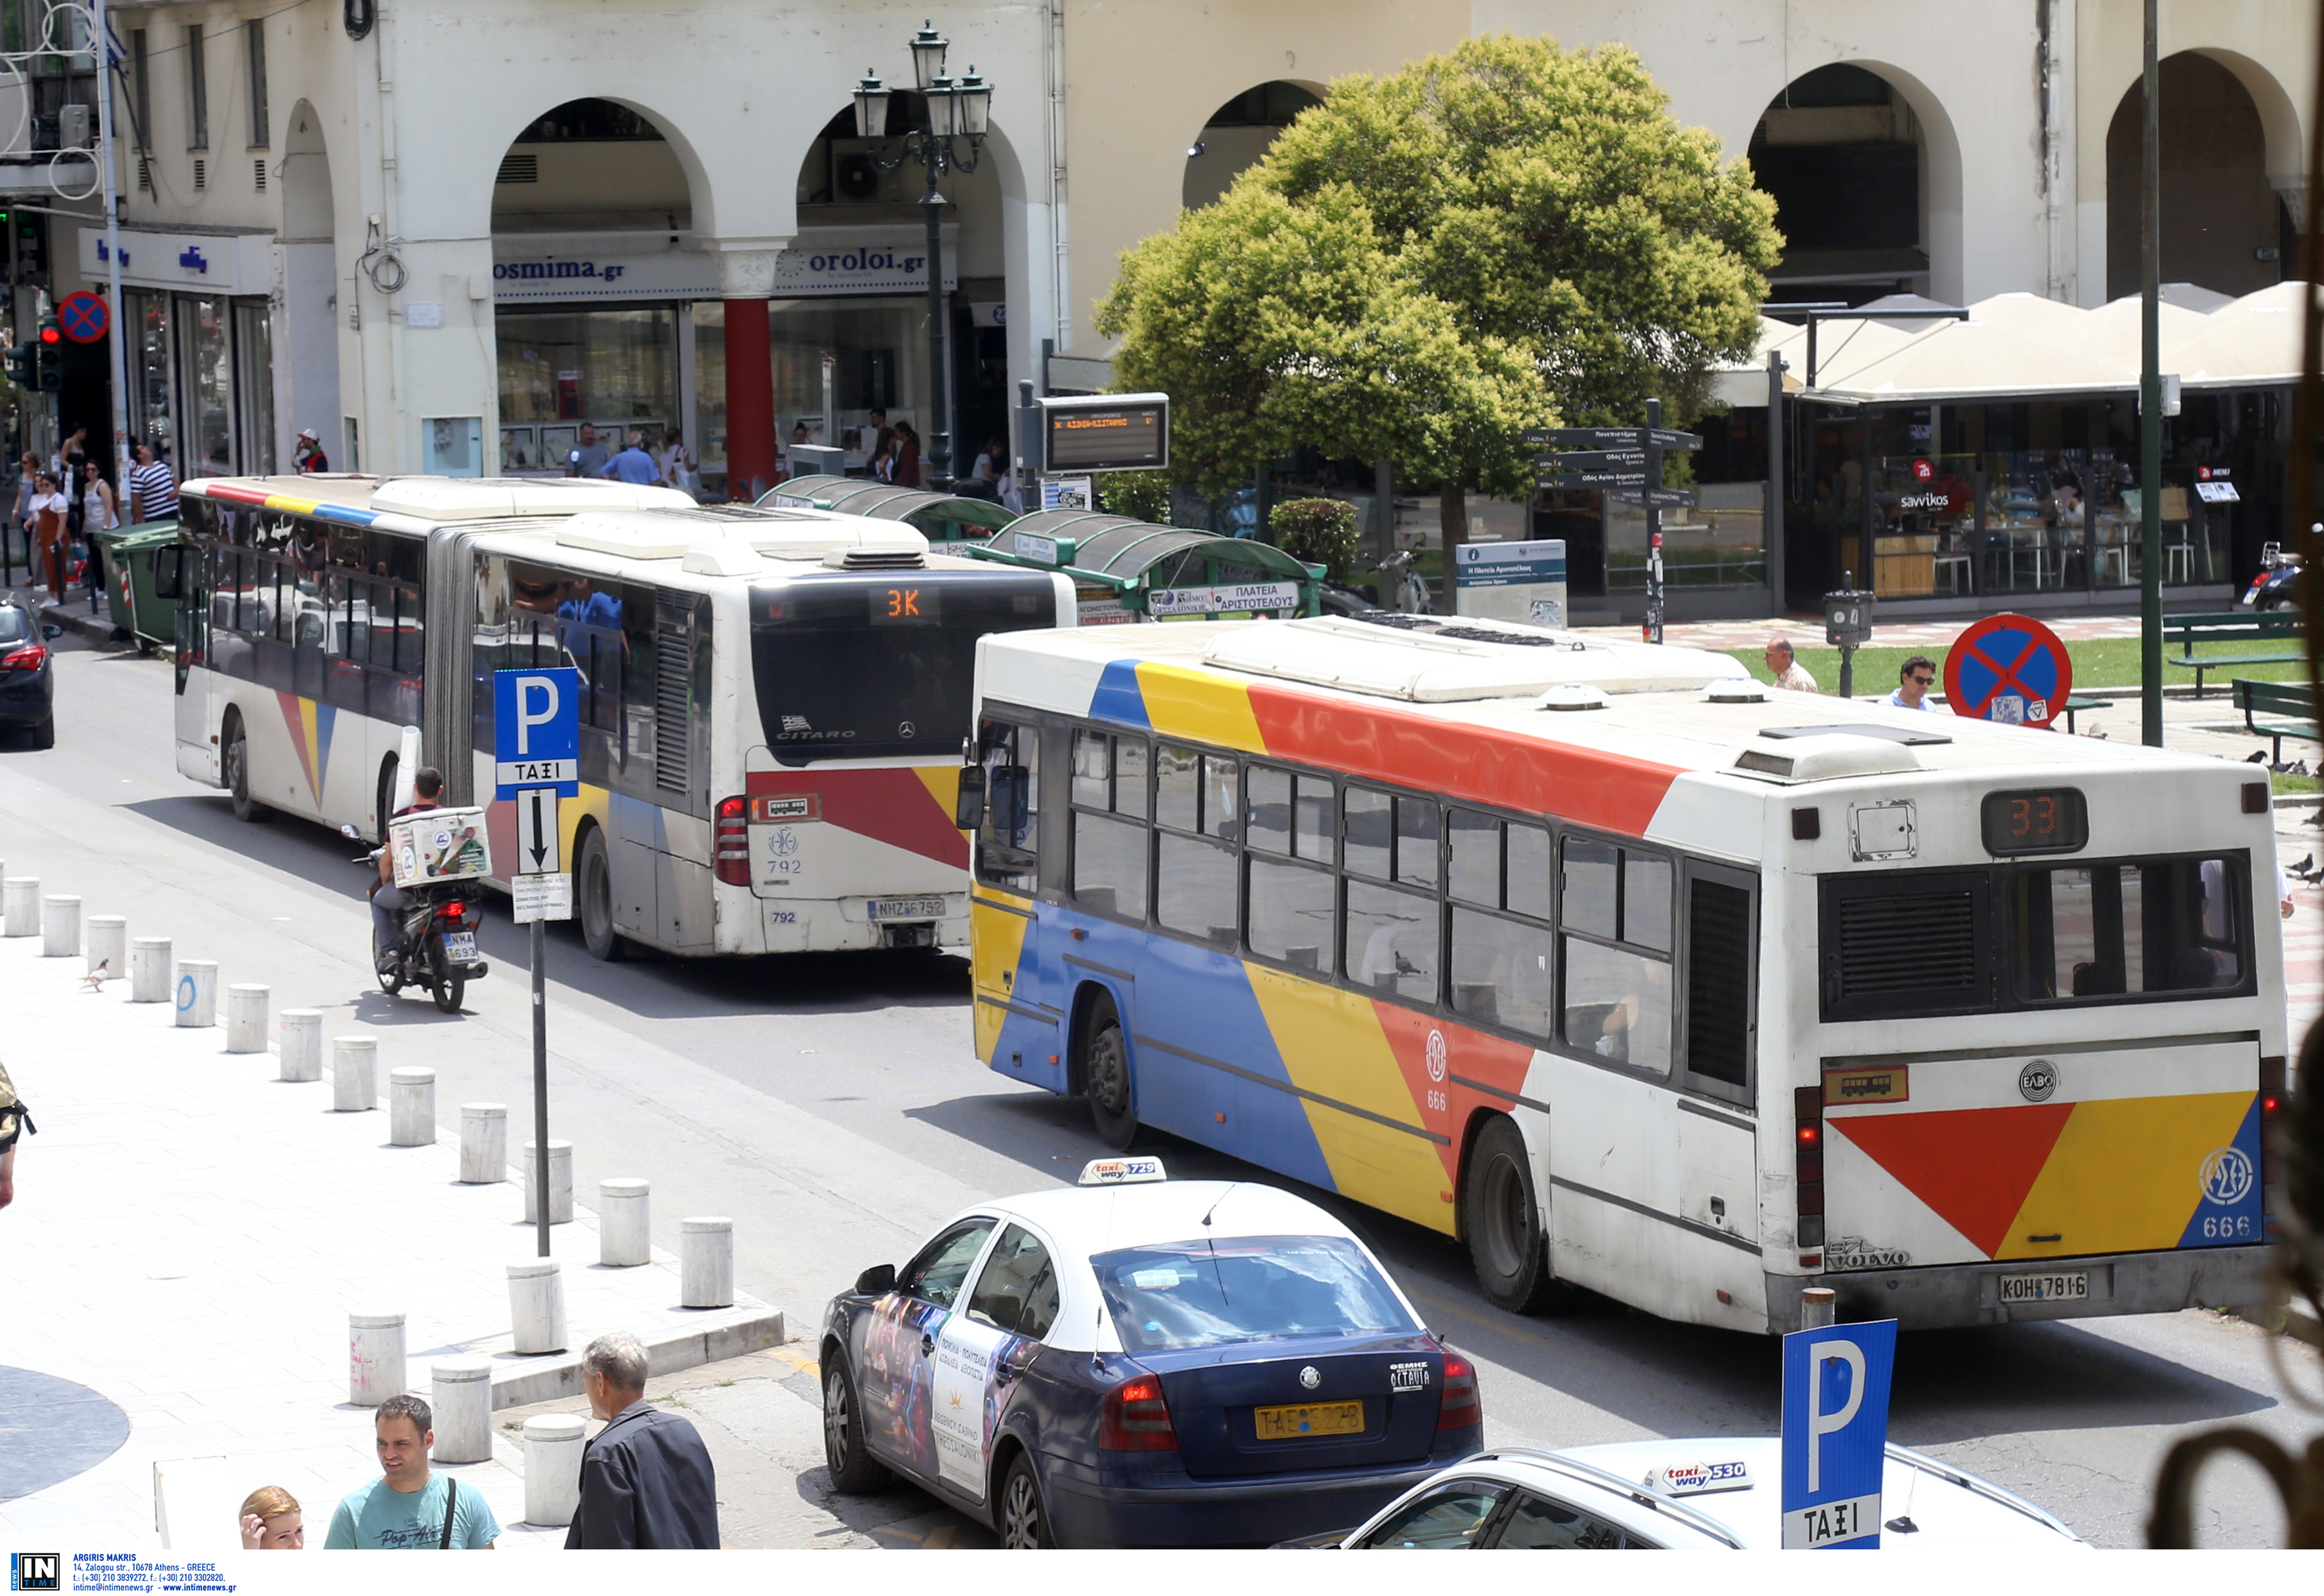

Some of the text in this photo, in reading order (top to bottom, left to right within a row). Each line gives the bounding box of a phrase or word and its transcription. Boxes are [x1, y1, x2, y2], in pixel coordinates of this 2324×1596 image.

[810, 247, 926, 273] oroloi.gr
[2212, 468, 2230, 476] MENU
[1901, 493, 1949, 508] savvikos
[1236, 585, 1278, 597] ΠΛΑΤΕΙΑ
[888, 590, 919, 615] 3K
[1221, 597, 1294, 610] ΑΡΙΣΤΟΤΕΛΟΥΣ
[516, 676, 559, 754] P
[776, 730, 855, 740] CITARO
[2011, 796, 2055, 834] 33
[767, 860, 801, 874] 792
[772, 912, 795, 922] 792
[455, 947, 475, 958] 693
[1428, 1090, 1446, 1112] 666
[1096, 1163, 1119, 1172] taxi
[1131, 1163, 1154, 1174] 729
[2204, 1216, 2250, 1238] 666
[1827, 1250, 1910, 1268] VOLVO
[962, 1347, 987, 1368] ΠΟΛΥΤΕΛΕΙΑ
[1391, 1371, 1430, 1387] OCTAVIA
[1808, 1340, 1866, 1494] P
[935, 1411, 978, 1441] REGENCY CASINO
[936, 1433, 981, 1465] THESSALONIKI
[1668, 1465, 1699, 1479] taxi
[1712, 1463, 1745, 1479] 530
[1676, 1476, 1707, 1486] way
